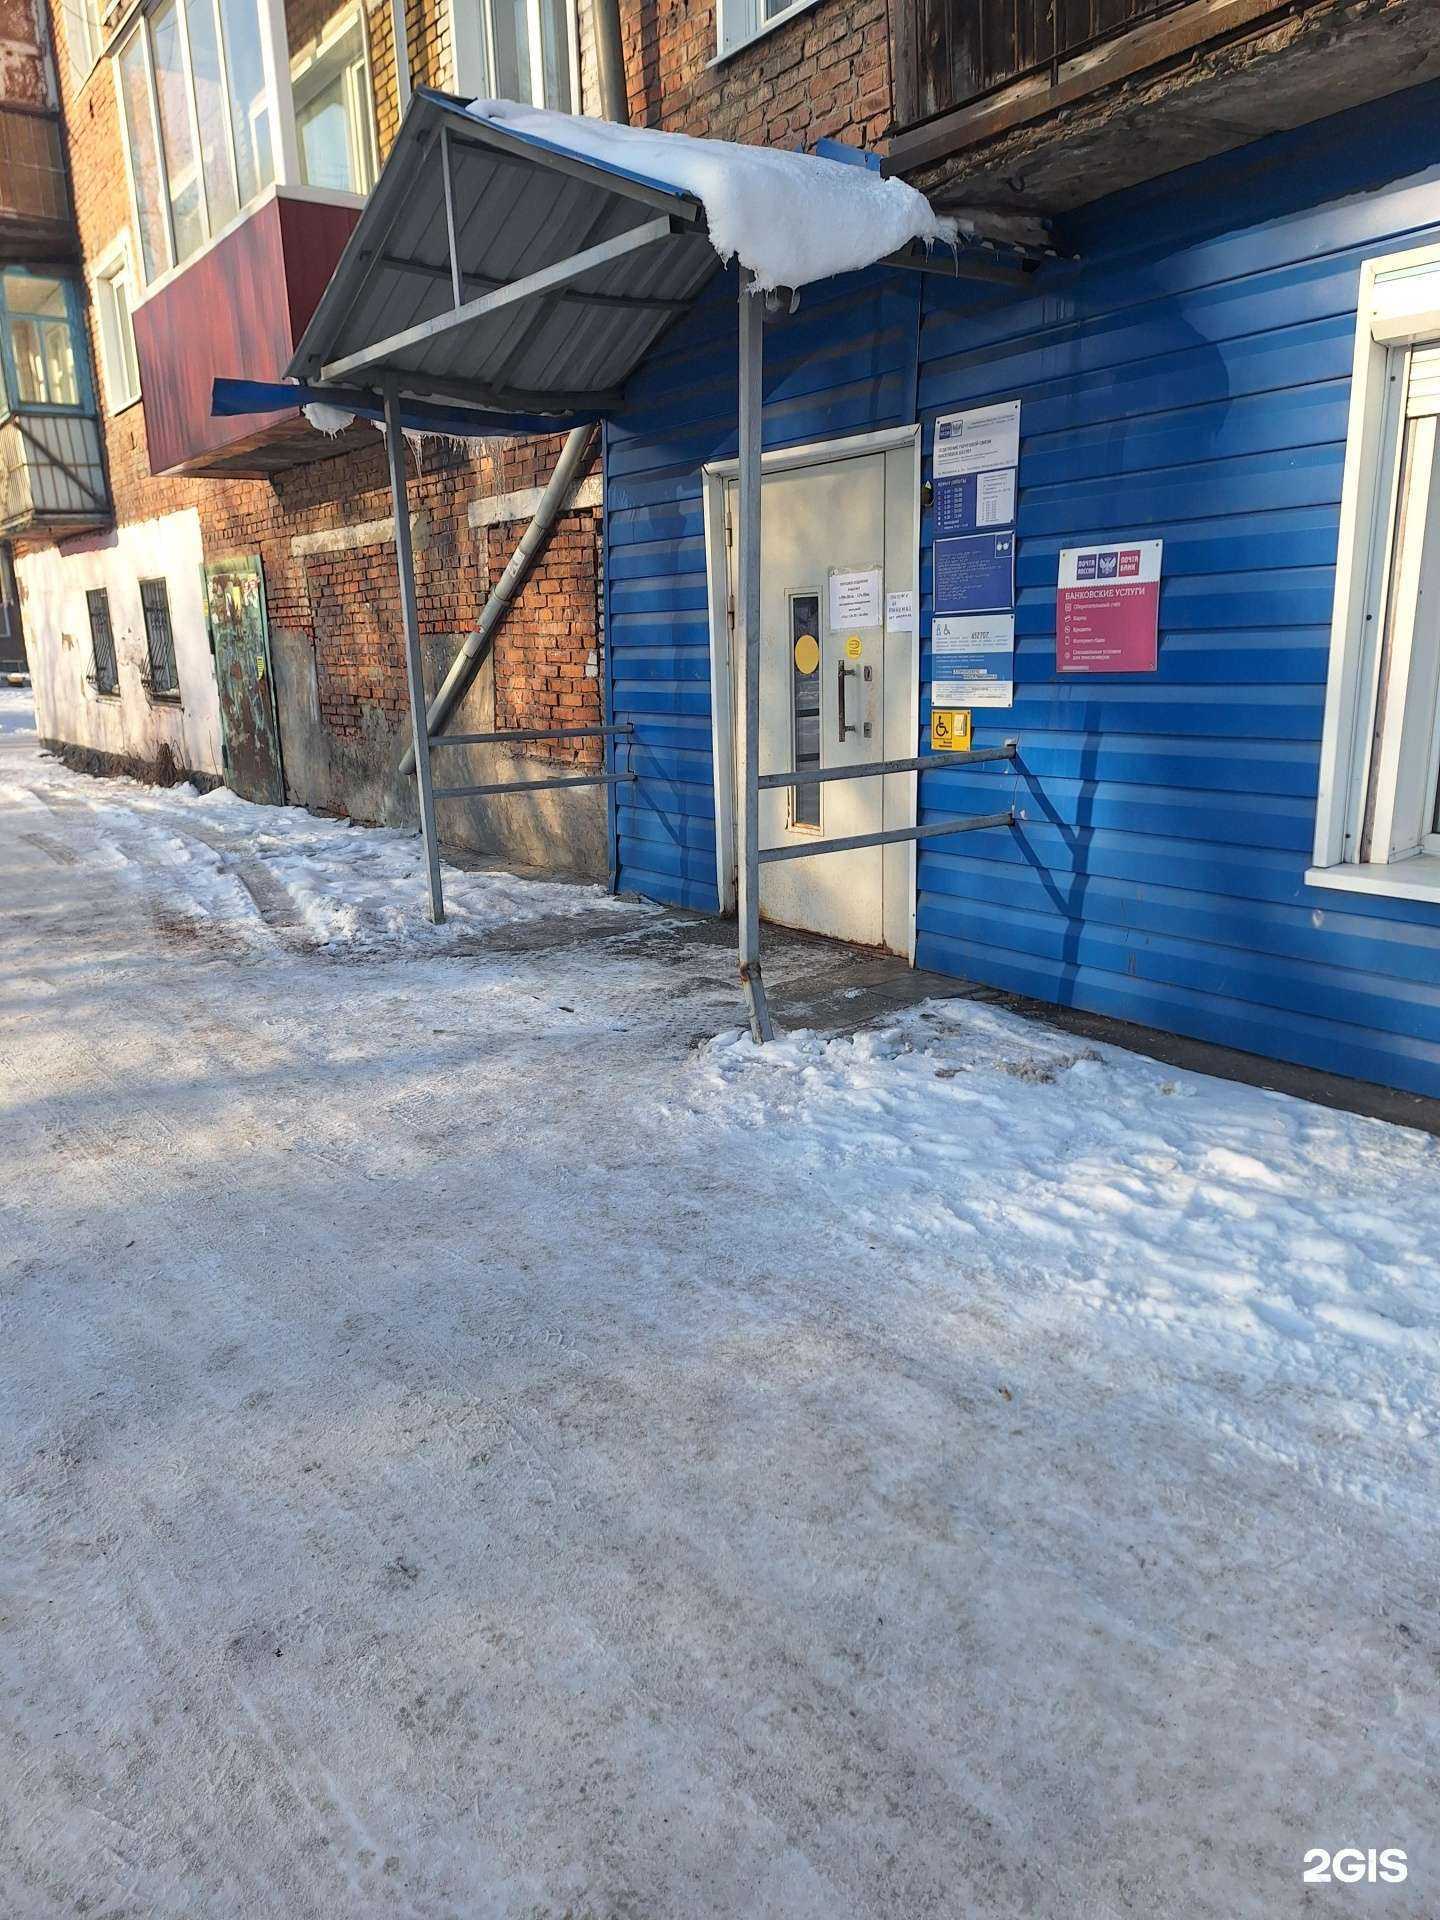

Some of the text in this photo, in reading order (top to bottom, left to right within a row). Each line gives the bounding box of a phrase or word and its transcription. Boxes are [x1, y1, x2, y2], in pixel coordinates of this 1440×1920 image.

[1078, 559, 1096, 567] ПОЧТА
[1077, 567, 1095, 575] РОССИИ
[1065, 586, 1145, 600] БАНКОВСКИЕ УСЛУГИ
